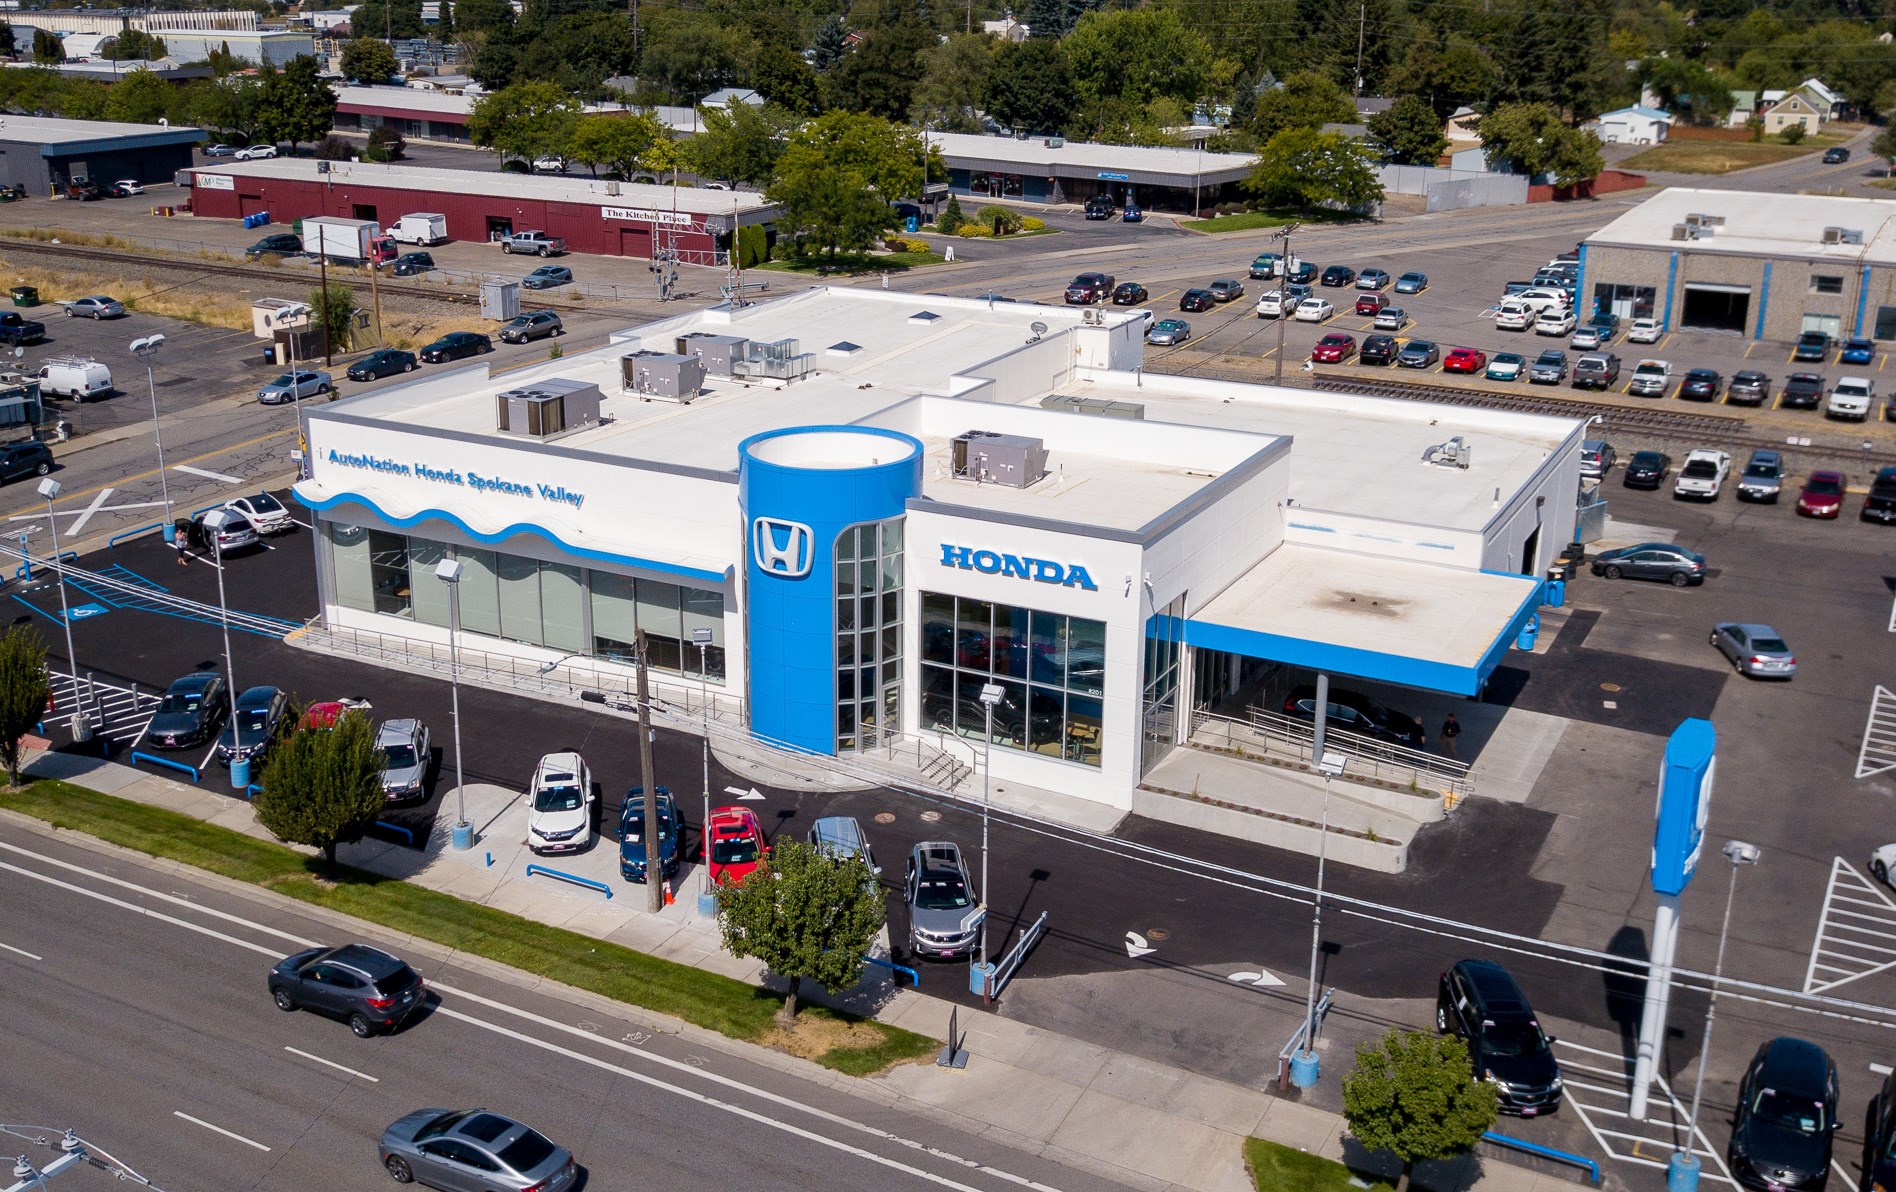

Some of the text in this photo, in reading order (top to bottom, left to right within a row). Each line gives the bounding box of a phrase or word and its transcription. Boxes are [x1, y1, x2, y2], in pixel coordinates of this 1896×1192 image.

[606, 209, 622, 217] The
[625, 211, 660, 221] Kitchen
[329, 449, 584, 509] AutoNation Honda Spokane Valley
[940, 543, 1098, 591] HONDA
